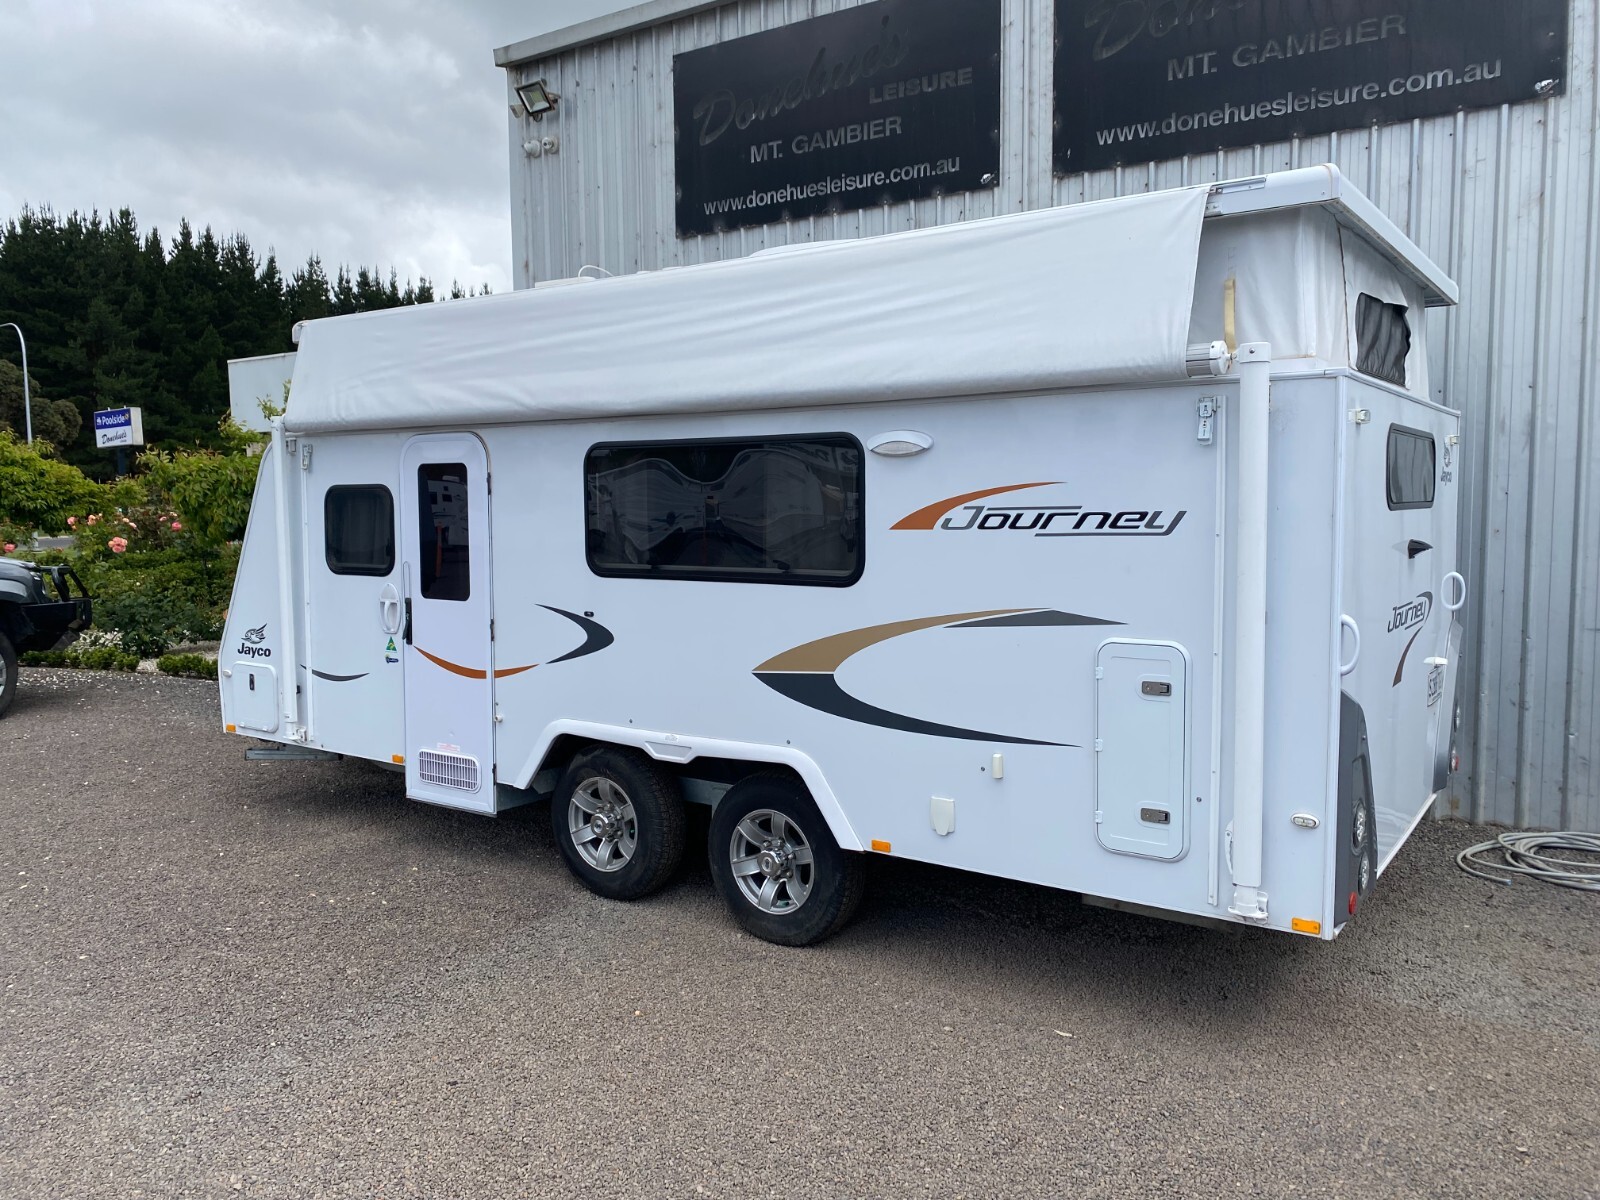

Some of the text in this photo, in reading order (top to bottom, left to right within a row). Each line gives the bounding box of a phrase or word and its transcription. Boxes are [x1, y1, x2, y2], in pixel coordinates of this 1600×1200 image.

[1167, 14, 1407, 82] MT. GAMBIER
[869, 66, 973, 105] LEISURE
[1097, 59, 1501, 146] www.donehuesleisure.com.au
[750, 115, 902, 164] MT. GAMBIER
[704, 156, 960, 215] www.donehuesleisure.com.au
[101, 413, 125, 426] Poolside
[940, 505, 1188, 537] Journey
[1387, 600, 1428, 633] Journey
[237, 642, 272, 658] Jayco
